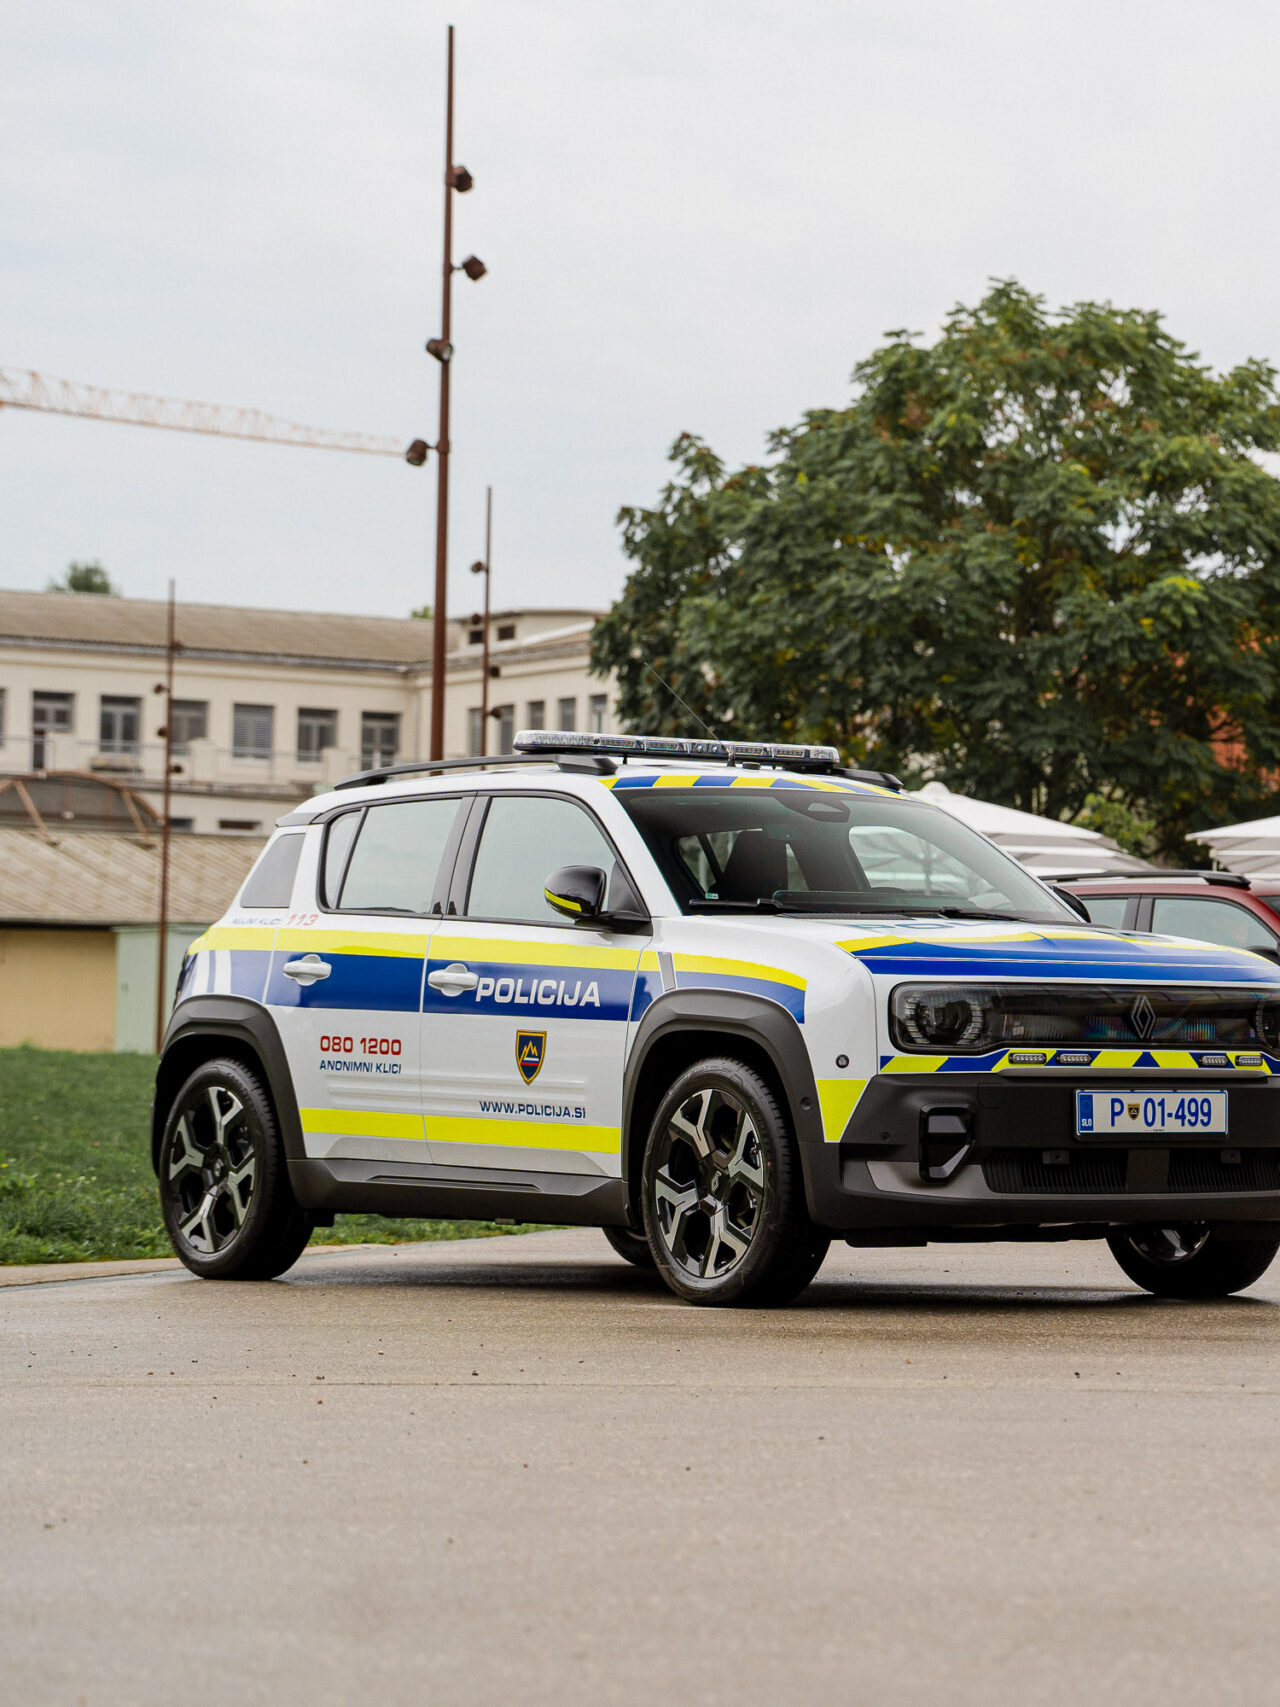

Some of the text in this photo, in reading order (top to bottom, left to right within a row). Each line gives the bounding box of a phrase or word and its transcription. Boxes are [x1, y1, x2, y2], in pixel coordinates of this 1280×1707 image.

[286, 913, 320, 927] 113
[475, 977, 601, 1008] POLICIJA
[320, 1035, 402, 1056] 080 1200
[319, 1059, 402, 1075] ANONIMNI KLICI
[479, 1100, 586, 1119] WWW.POLICIJA.SI
[1110, 1097, 1212, 1128] P 01-499
[1081, 1118, 1093, 1127] SLO
